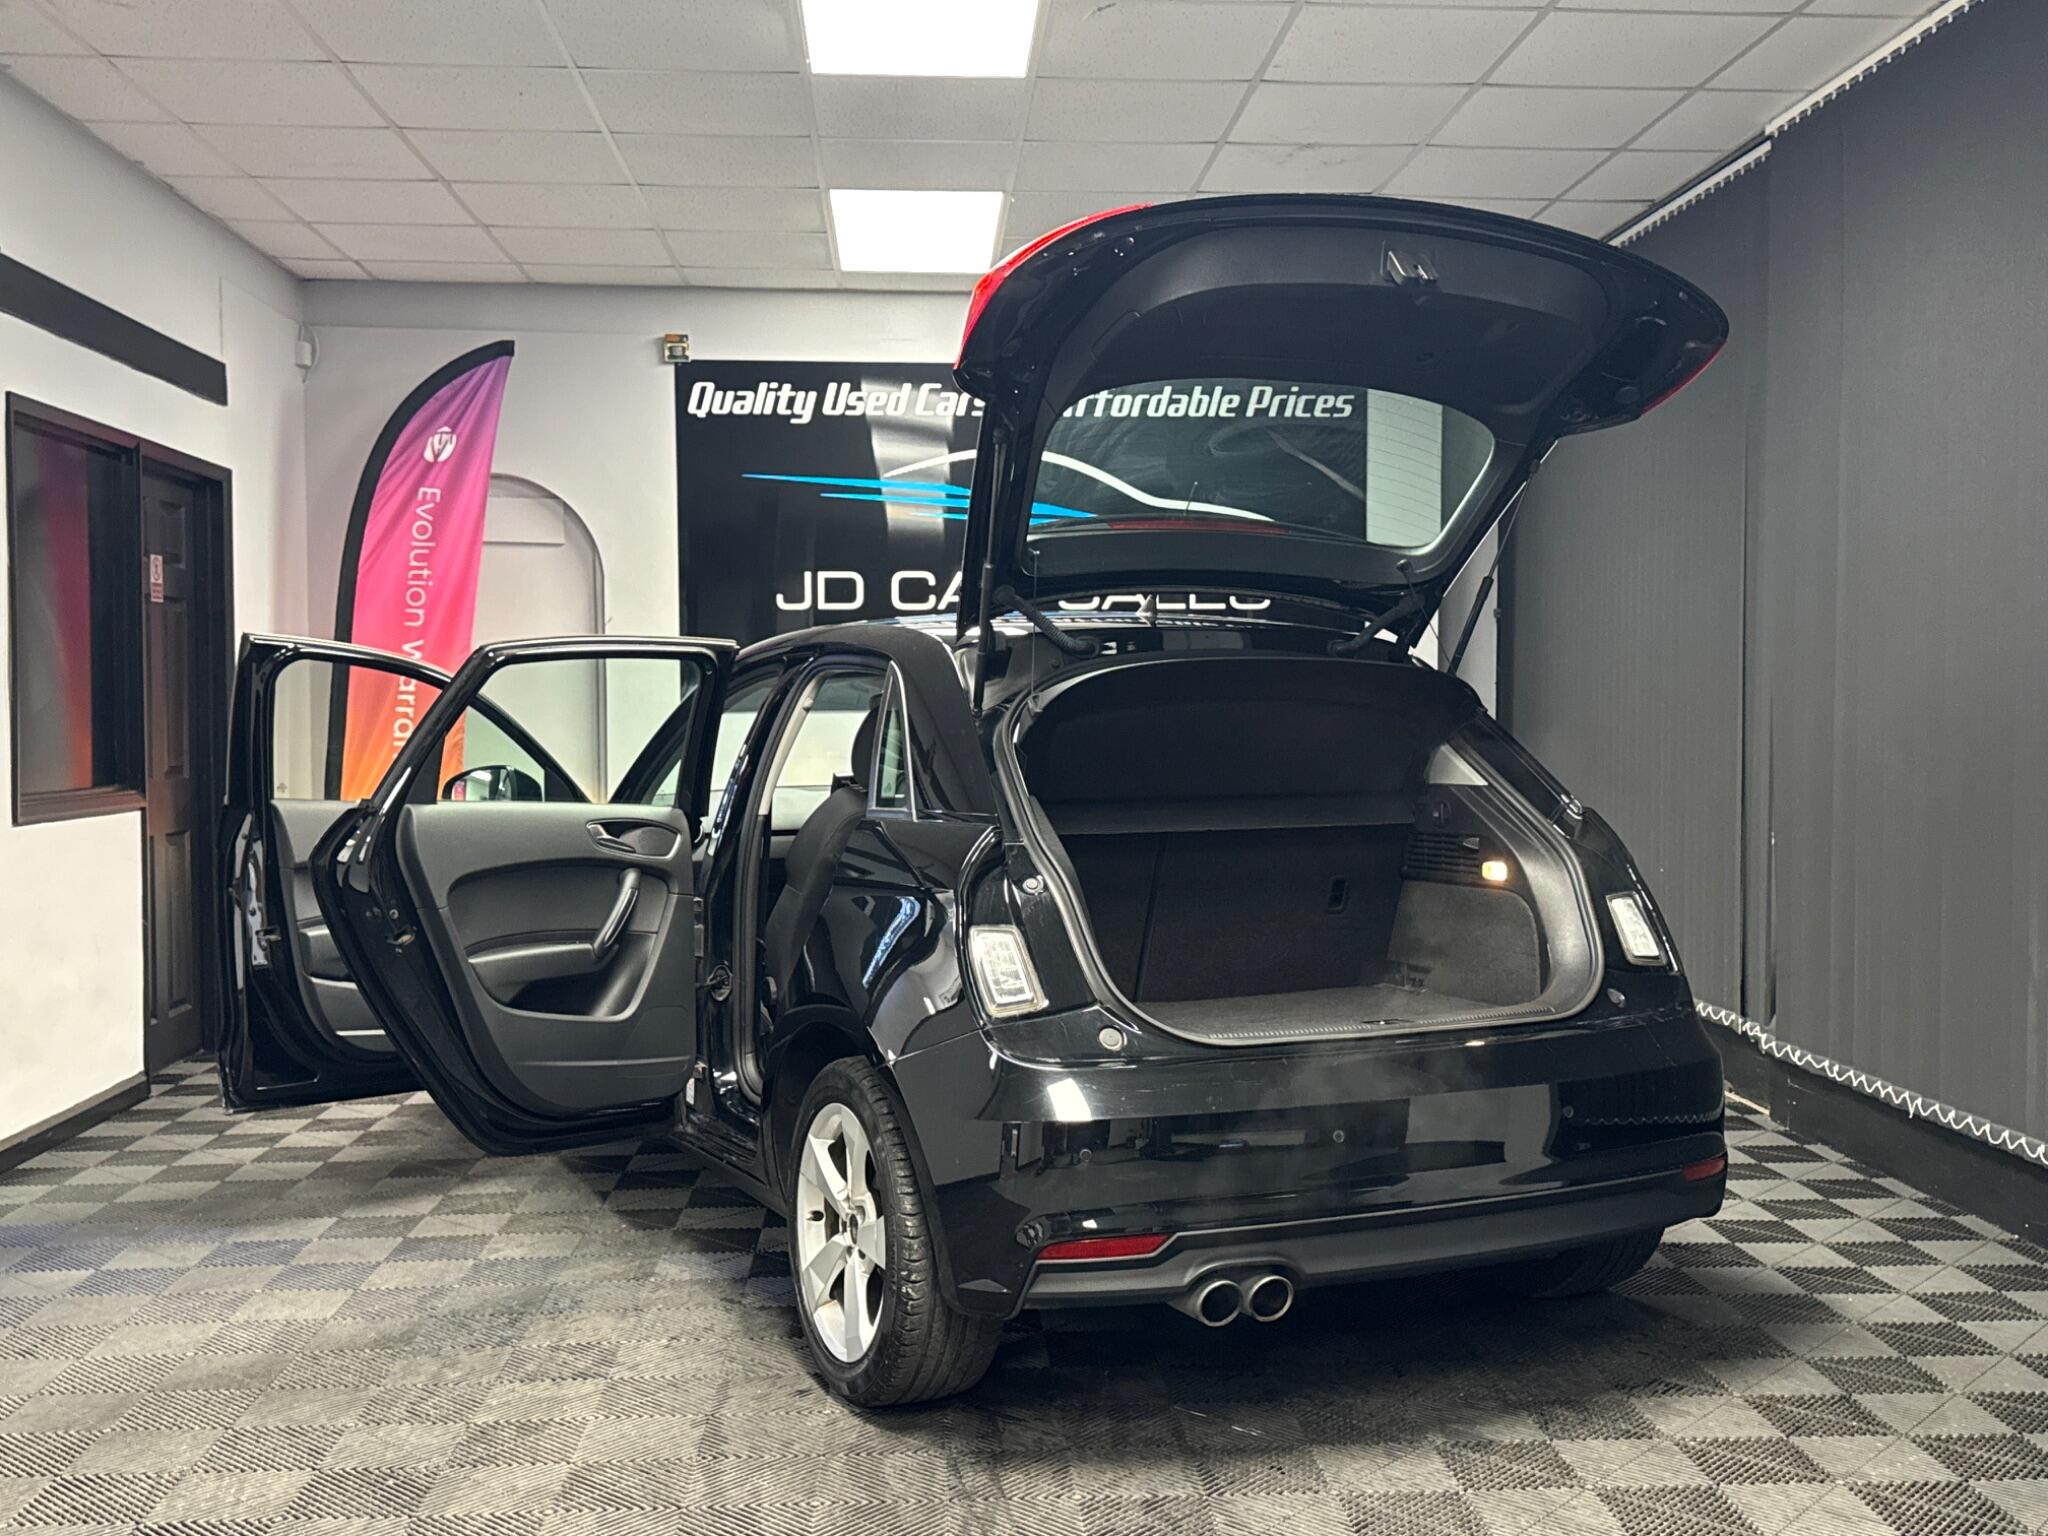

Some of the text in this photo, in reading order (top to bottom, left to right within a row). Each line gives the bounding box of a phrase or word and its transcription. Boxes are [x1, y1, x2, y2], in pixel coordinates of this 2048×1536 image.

[687, 381, 817, 424] Quality
[822, 382, 912, 416] Used
[914, 382, 986, 417] Cars
[1246, 385, 1354, 418] Prices
[403, 486, 442, 627] Evolution
[775, 570, 963, 611] JD CA
